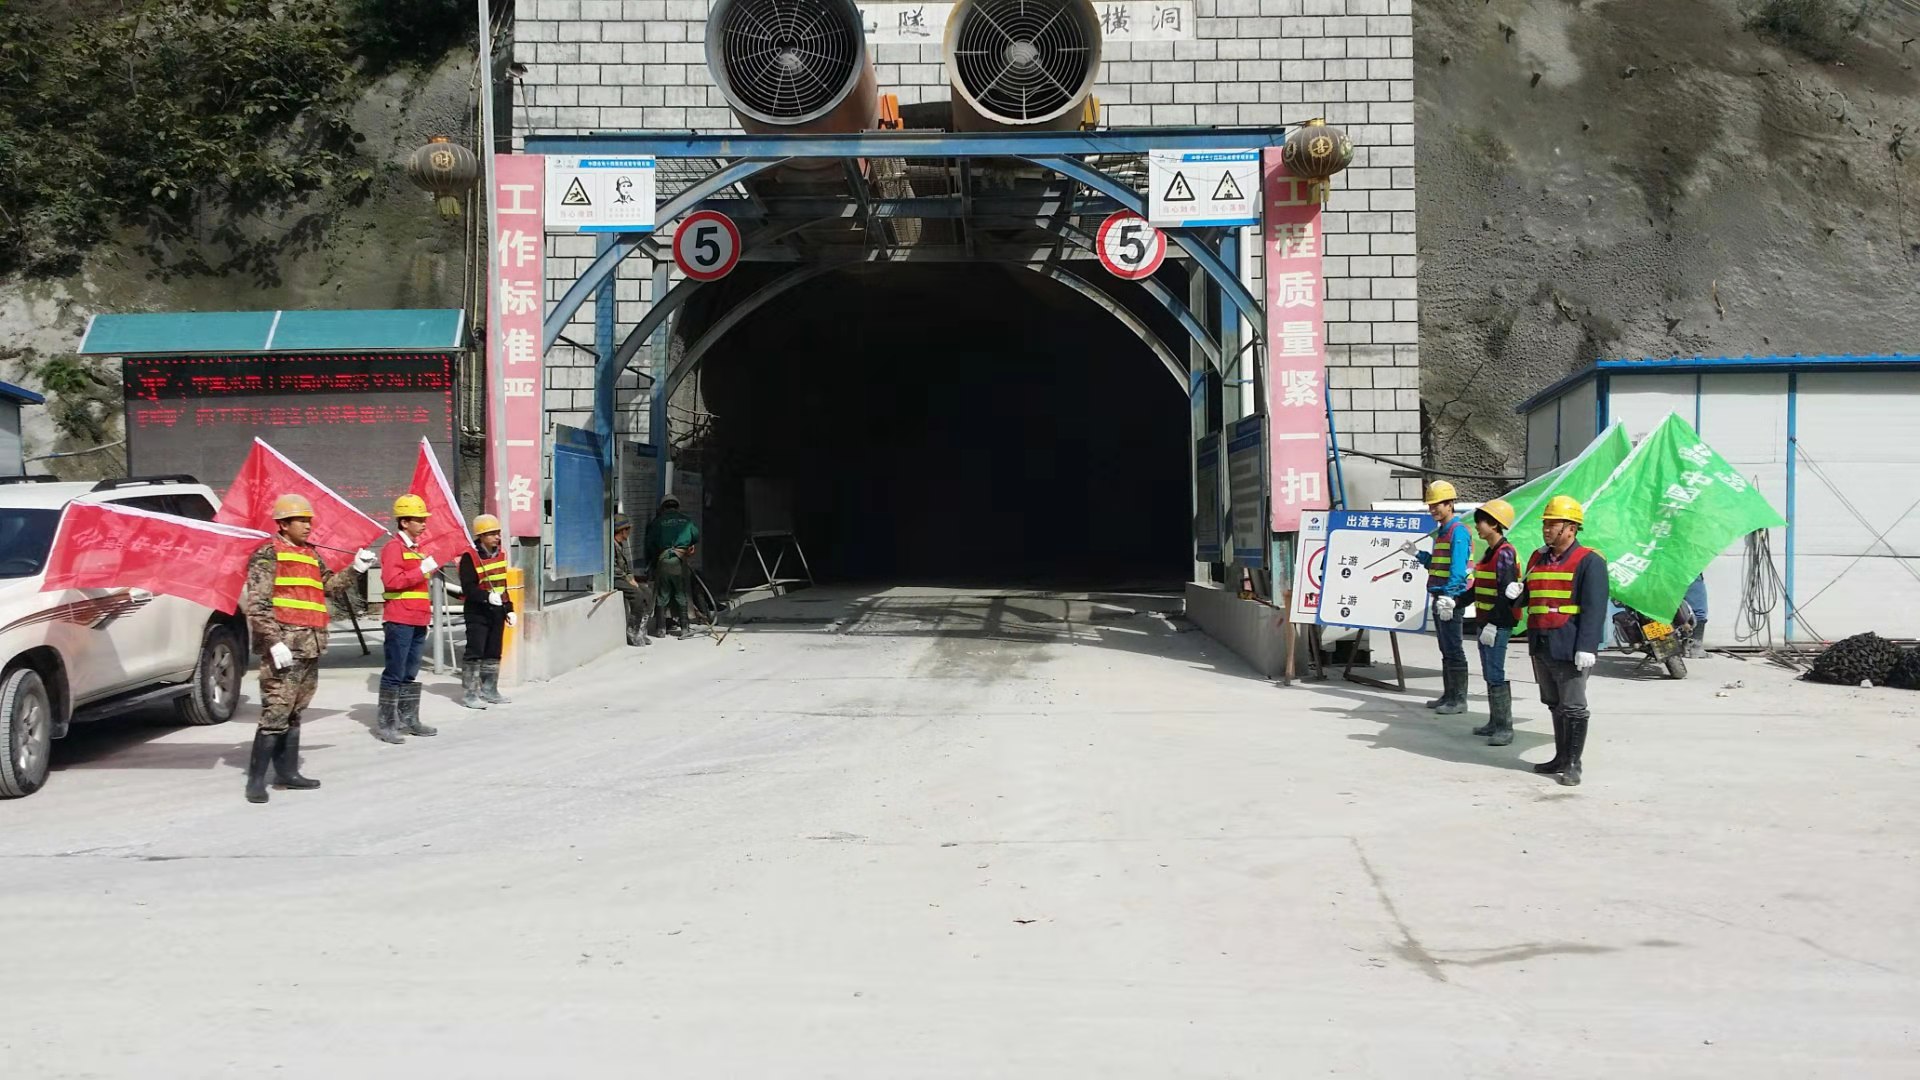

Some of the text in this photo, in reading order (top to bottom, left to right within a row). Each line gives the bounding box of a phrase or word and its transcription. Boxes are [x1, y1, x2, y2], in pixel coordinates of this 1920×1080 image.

[695, 226, 720, 266] 5
[1119, 225, 1145, 264] 5
[1274, 175, 1322, 505] 工程质量紧一扣
[1346, 515, 1421, 530] 出渣车标志图
[1338, 555, 1358, 566] 上游
[1399, 559, 1420, 570] 下游
[1337, 595, 1358, 606] 上游
[1392, 599, 1412, 610] 下游
